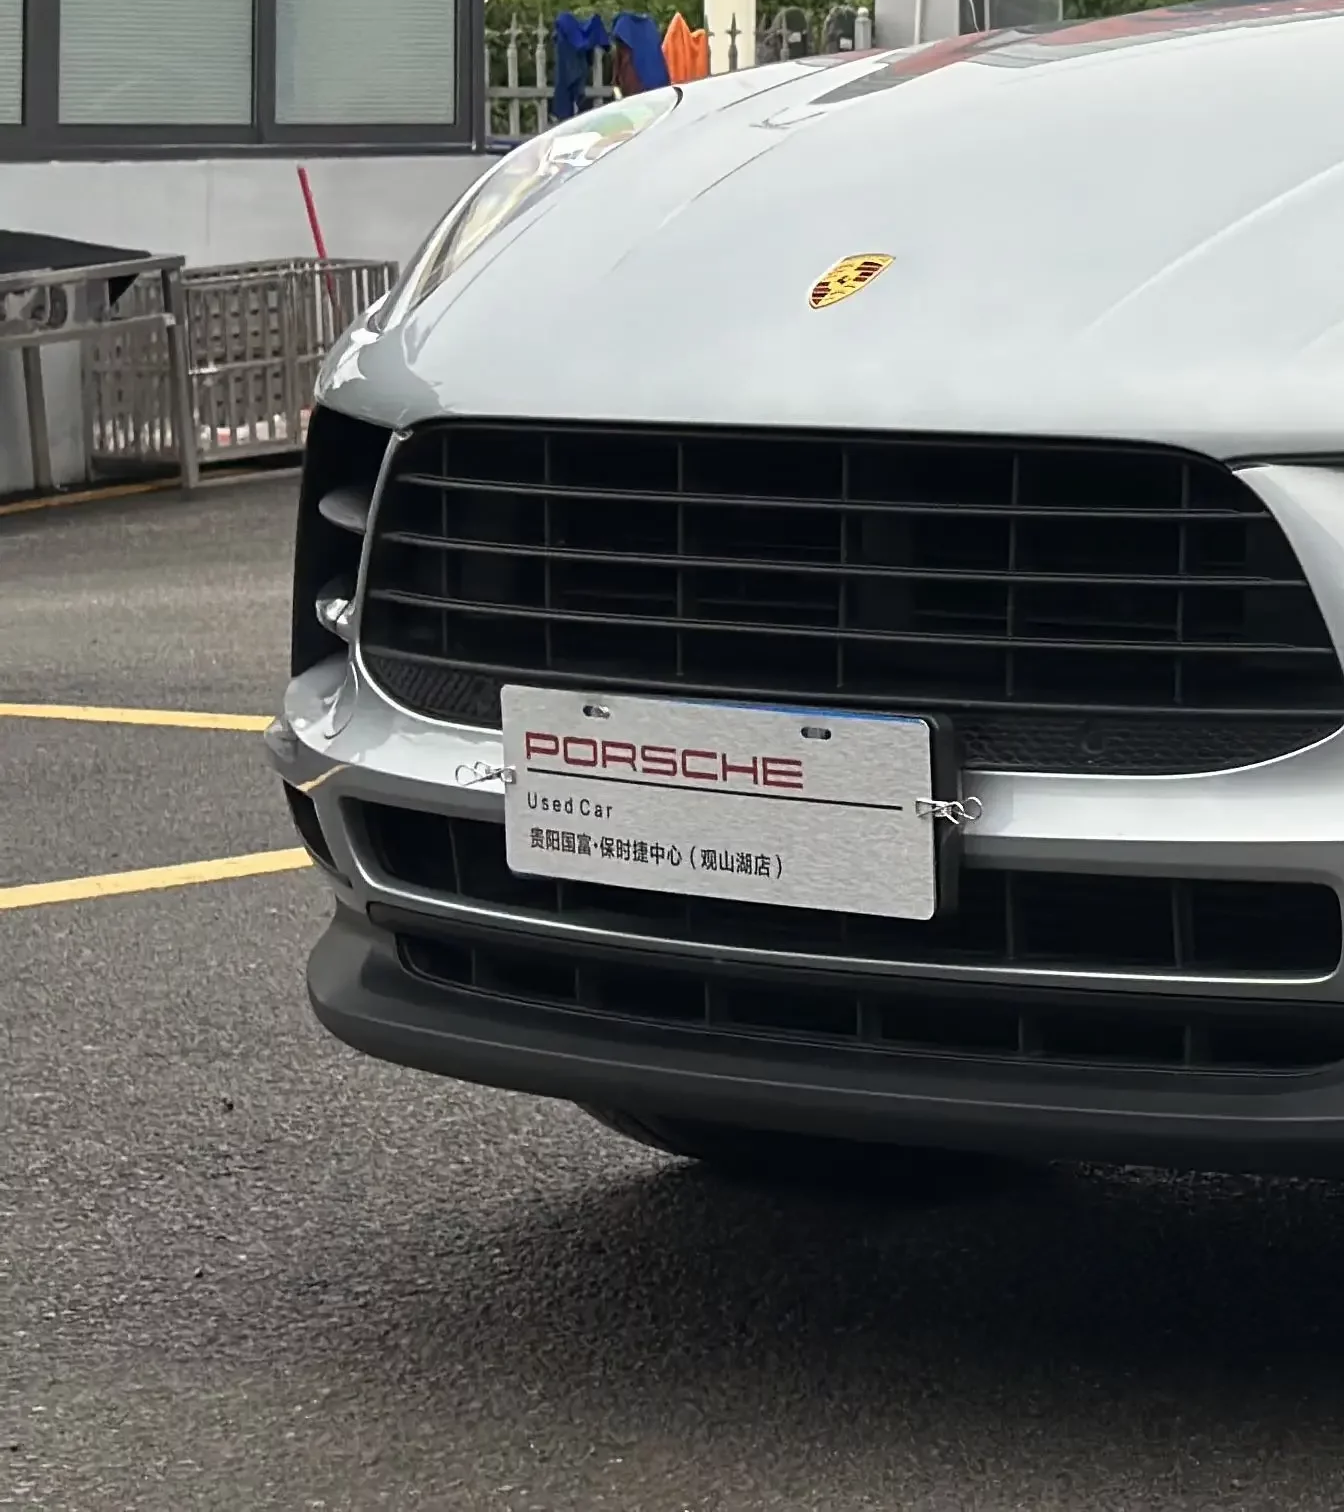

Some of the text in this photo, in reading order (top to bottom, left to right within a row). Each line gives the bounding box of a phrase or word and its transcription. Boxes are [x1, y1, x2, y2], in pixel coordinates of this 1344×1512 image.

[525, 732, 804, 789] PORSCHE
[527, 791, 613, 820] Used Car
